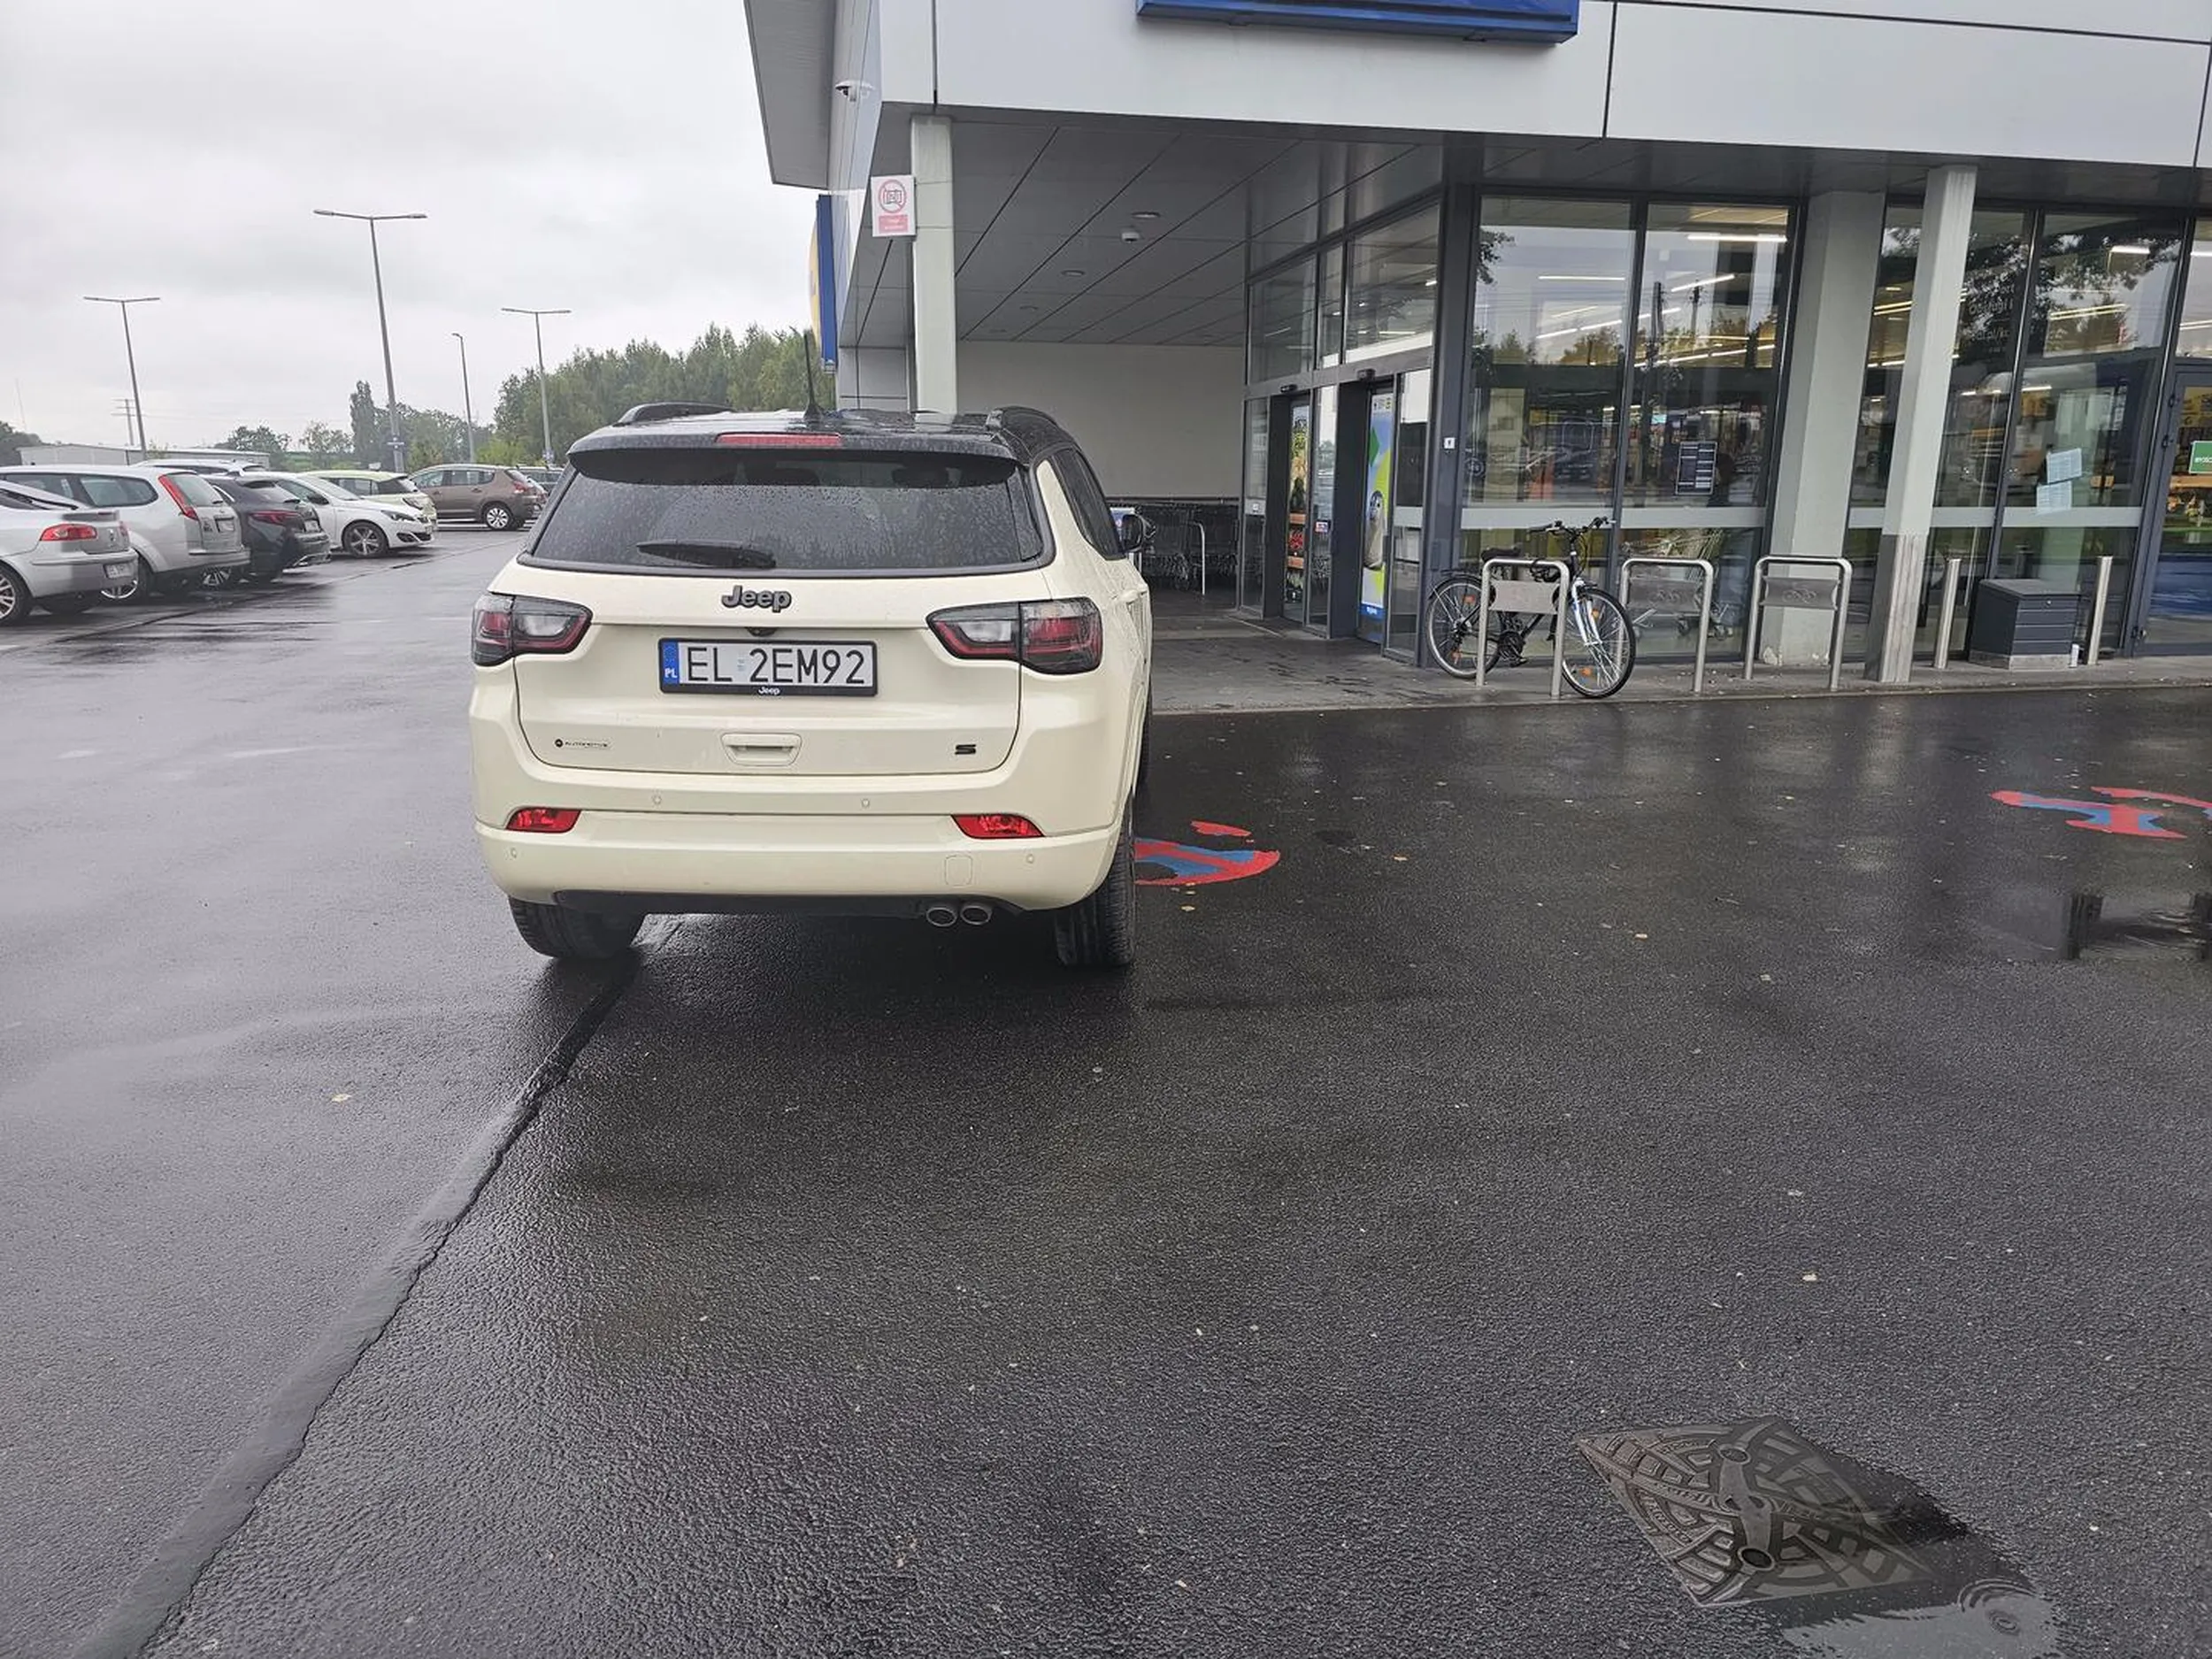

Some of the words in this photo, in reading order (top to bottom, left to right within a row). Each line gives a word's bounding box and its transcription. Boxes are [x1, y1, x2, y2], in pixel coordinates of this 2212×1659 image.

[721, 585, 792, 612] Jeep
[687, 646, 733, 682] EL
[749, 648, 865, 684] 2EM92
[664, 668, 679, 679] PL
[757, 686, 780, 695] Jeep
[955, 744, 977, 755] S
